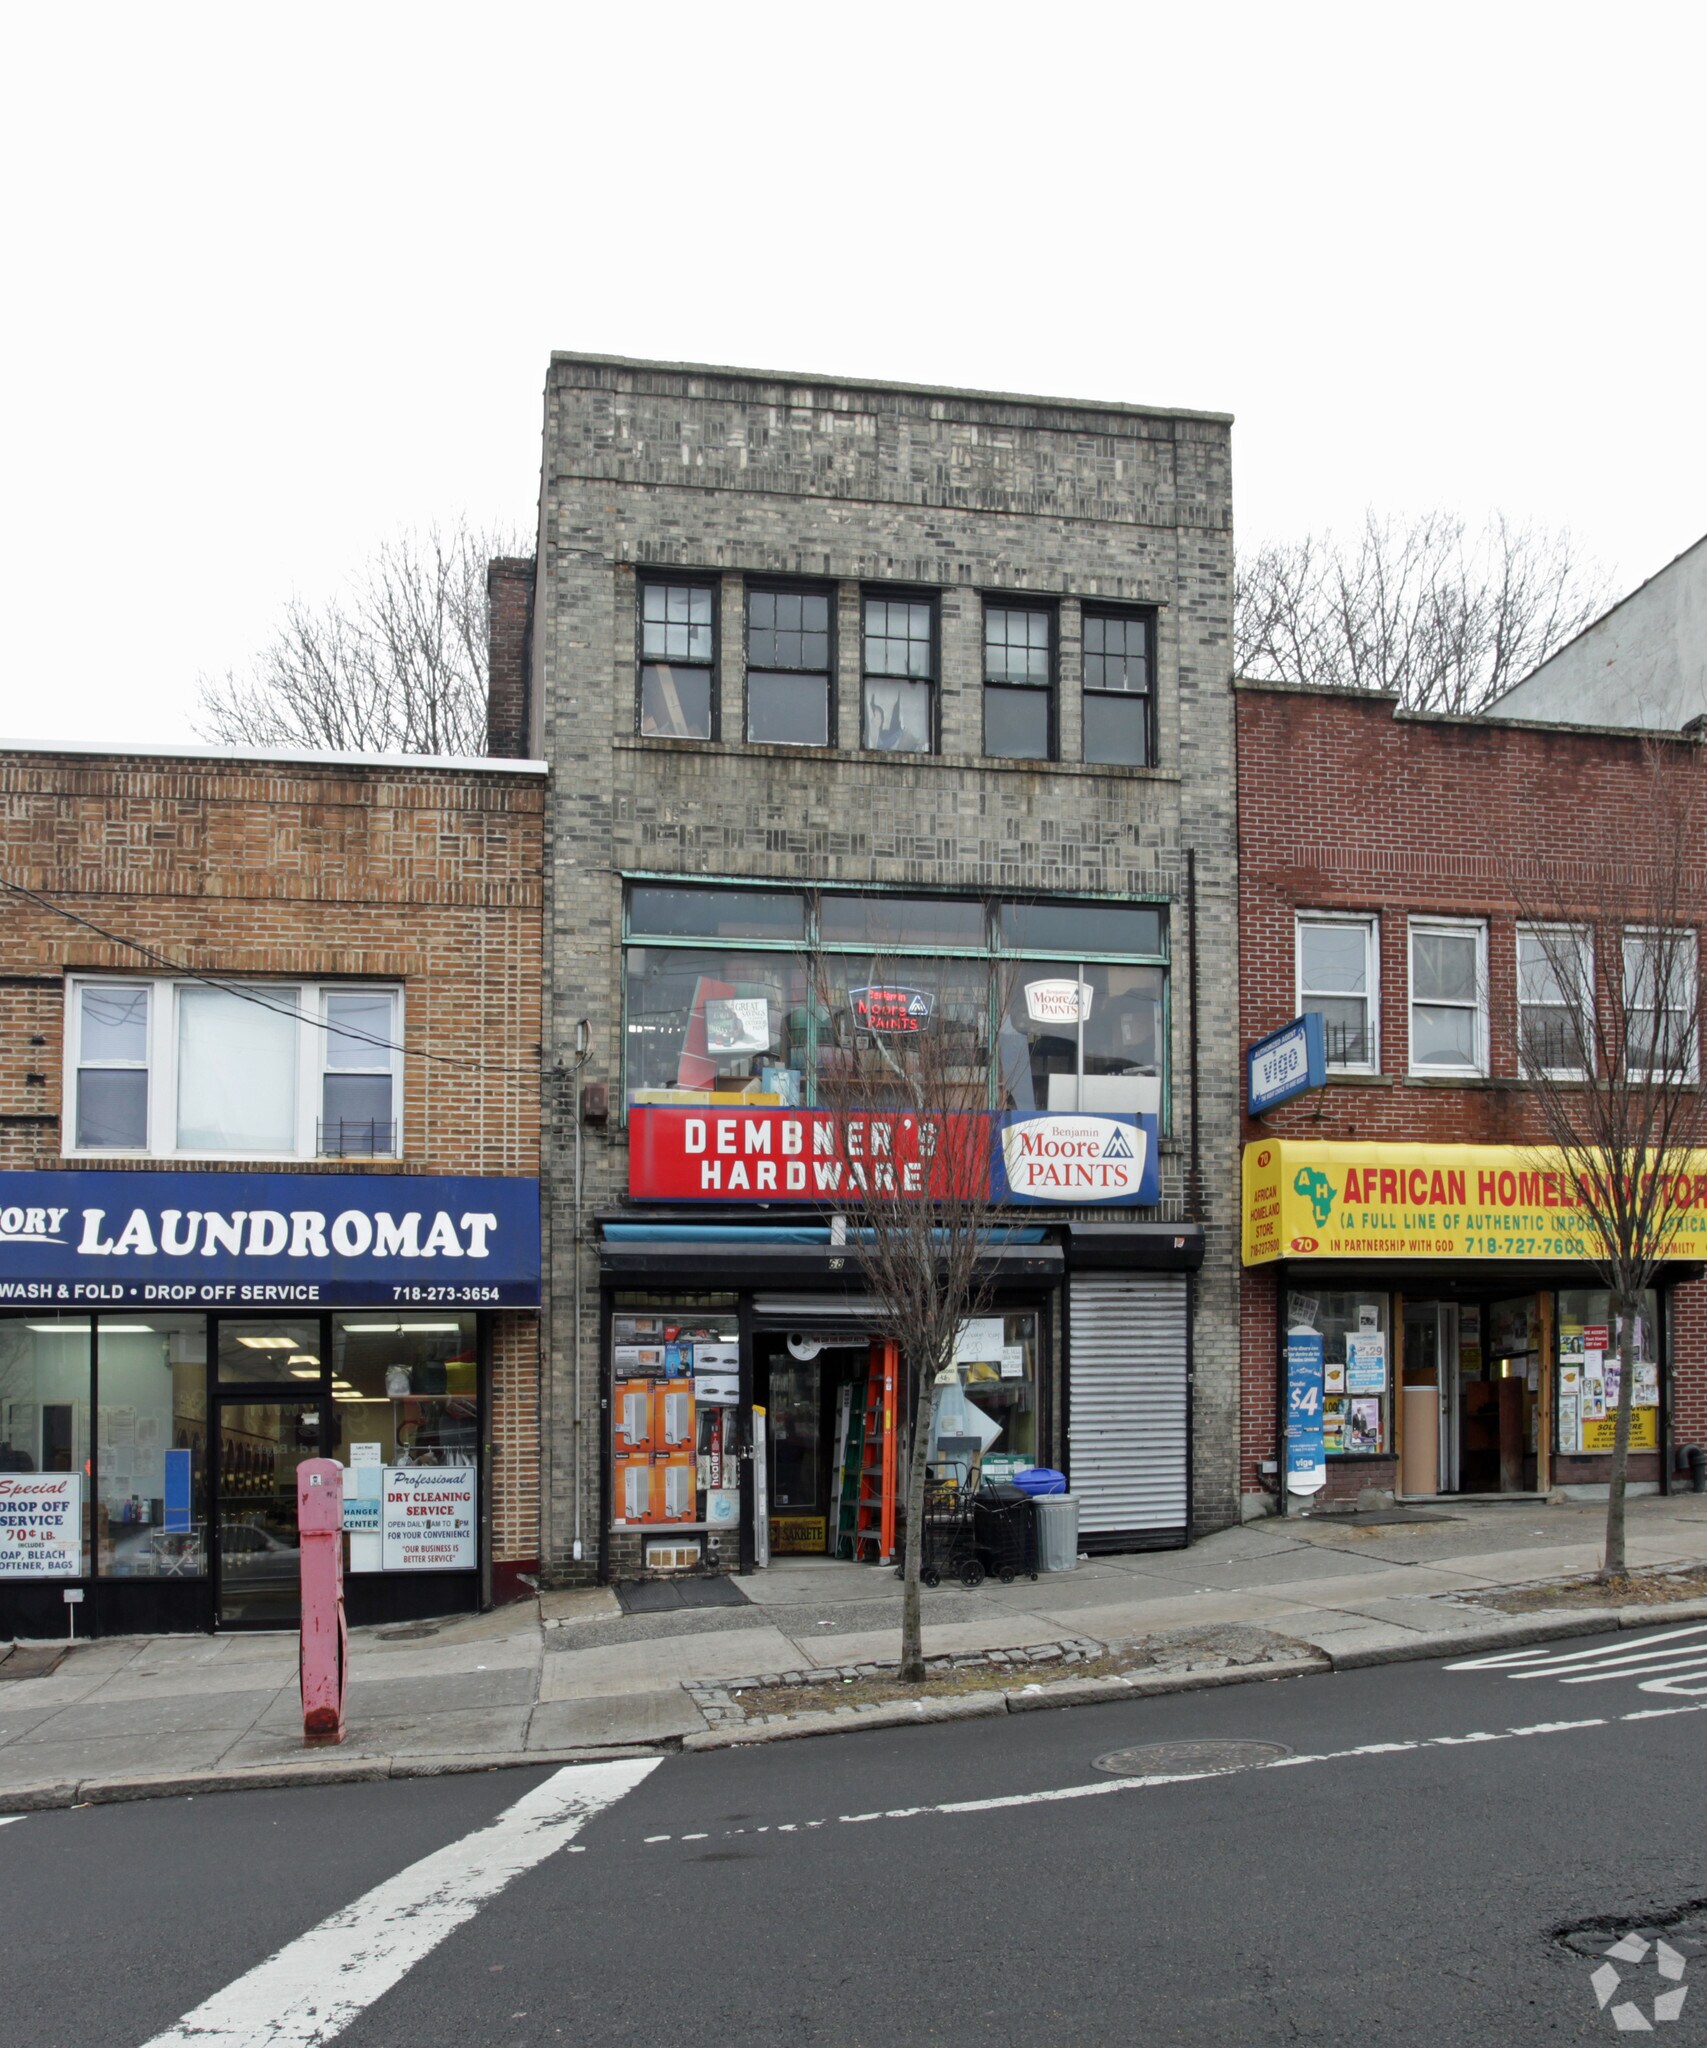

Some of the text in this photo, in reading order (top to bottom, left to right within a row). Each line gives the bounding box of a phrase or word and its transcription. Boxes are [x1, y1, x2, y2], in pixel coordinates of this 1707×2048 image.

[1033, 991, 1070, 1003] Moore
[735, 1002, 758, 1011] GREAT
[857, 999, 907, 1016] Moore
[1041, 1003, 1078, 1014] PAINTS
[866, 1015, 919, 1030] PAINTS
[1281, 1028, 1297, 1044] AGENT
[684, 1119, 938, 1157] DEMBNER'S
[1052, 1127, 1099, 1138] Benjamin
[1020, 1132, 1100, 1158] Moore
[1260, 1153, 1268, 1166] 70
[701, 1160, 922, 1191] HARDWARE
[1026, 1163, 1128, 1187] PAINTS
[1343, 1168, 1467, 1205] AFRICAN
[1254, 1185, 1277, 1203] AFRICAN
[1250, 1202, 1280, 1222] HOMELAND
[0, 1207, 69, 1233] ORY
[1340, 1211, 1354, 1229] (A
[1362, 1213, 1396, 1229] FULL
[1404, 1213, 1436, 1229] LINE
[1443, 1213, 1460, 1229] OF
[1466, 1214, 1544, 1231] AUTHENTIC
[1551, 1215, 1613, 1232] IMPORS
[77, 1208, 498, 1258] LAUNDROMAT
[1256, 1222, 1274, 1239] STORE
[1297, 1239, 1313, 1251] 70
[1330, 1239, 1454, 1252] IN PARTNERSHIP WITH GOD
[829, 1258, 845, 1270] 68
[0, 1284, 320, 1300] WASH & FOLD DROP OFF SERVICE
[393, 1286, 500, 1301] 718-273-3654
[1290, 1387, 1318, 1416] $4
[711, 1452, 719, 1486] heater
[1295, 1458, 1313, 1468] vigo
[394, 1472, 466, 1488] Professional
[0, 1480, 67, 1497] Special
[388, 1492, 471, 1502] DRY CLEANING
[41, 1501, 70, 1512] OFF
[344, 1508, 378, 1516] HANGER
[406, 1505, 455, 1516] SERVICE
[0, 1515, 63, 1526] SERVICE
[344, 1520, 379, 1528] CENTER
[426, 1519, 441, 1529] AM
[403, 1531, 421, 1539] YOUR
[423, 1530, 470, 1538] CONVENIENCE
[421, 1544, 451, 1552] BUSINESS
[453, 1544, 459, 1552] IS
[0, 1551, 65, 1560] OAP, BLEACH
[403, 1555, 426, 1563] BETTER
[0, 1561, 73, 1571] OFTENER, BAGS
